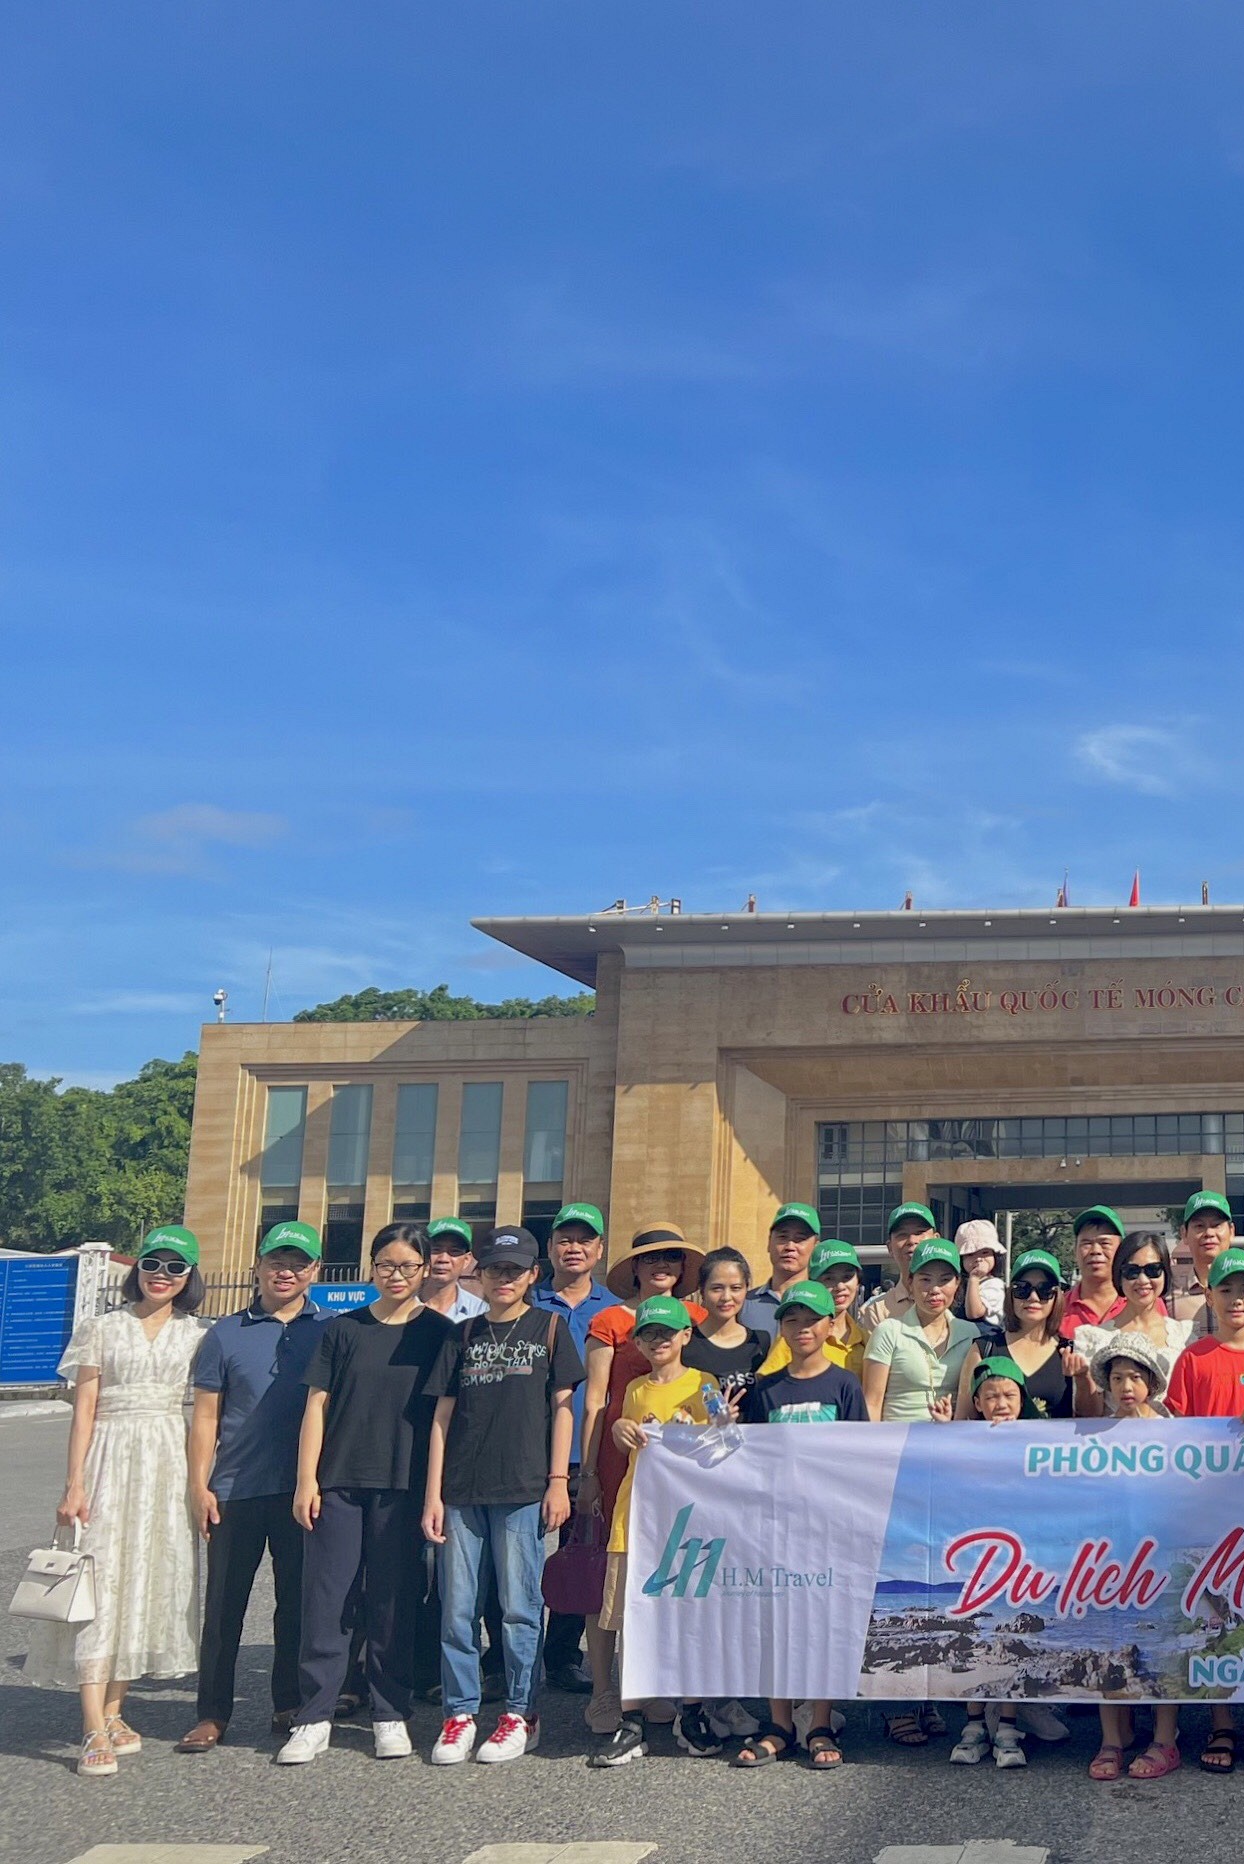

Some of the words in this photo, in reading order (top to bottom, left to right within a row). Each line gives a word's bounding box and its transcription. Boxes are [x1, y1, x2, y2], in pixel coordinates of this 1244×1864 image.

[841, 983, 899, 1014] CỬA
[907, 979, 992, 1013] KHẨU
[1000, 979, 1079, 1014] QUỐC
[1089, 978, 1124, 1009] TẾ
[1133, 980, 1216, 1008] MÓNG
[328, 1291, 346, 1302] KHU
[348, 1291, 366, 1304] VỰC
[1027, 1438, 1164, 1473] PHÒNG
[721, 1567, 763, 1587] H.M
[771, 1567, 834, 1587] Travel
[945, 1530, 1056, 1615] Du
[1060, 1540, 1168, 1615] lịch
